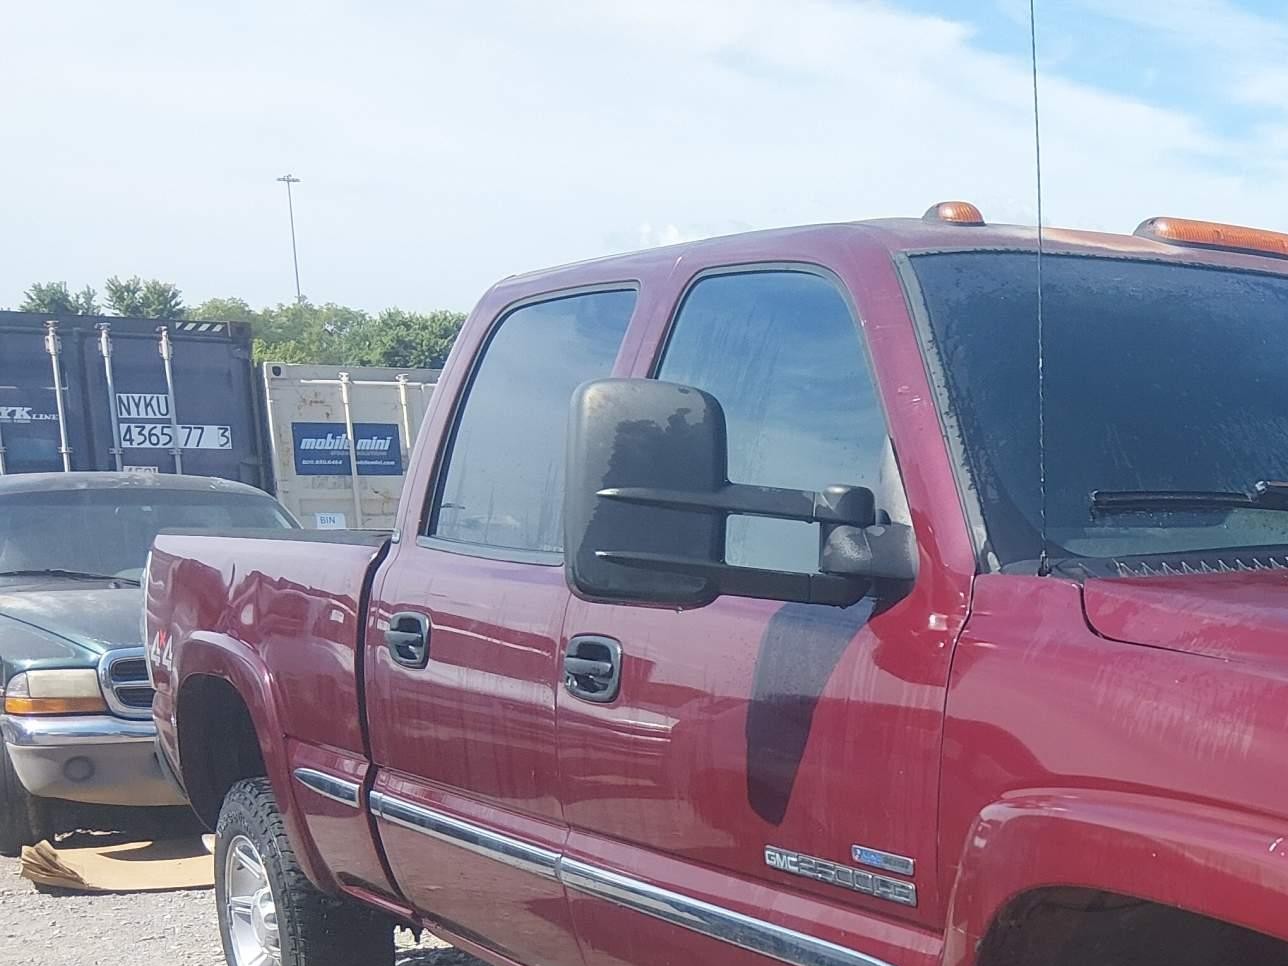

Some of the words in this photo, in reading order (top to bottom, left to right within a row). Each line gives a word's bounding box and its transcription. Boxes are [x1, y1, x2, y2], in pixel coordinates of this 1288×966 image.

[117, 395, 169, 417] NYKU
[356, 436, 392, 450] mini
[765, 850, 799, 872] GMC
